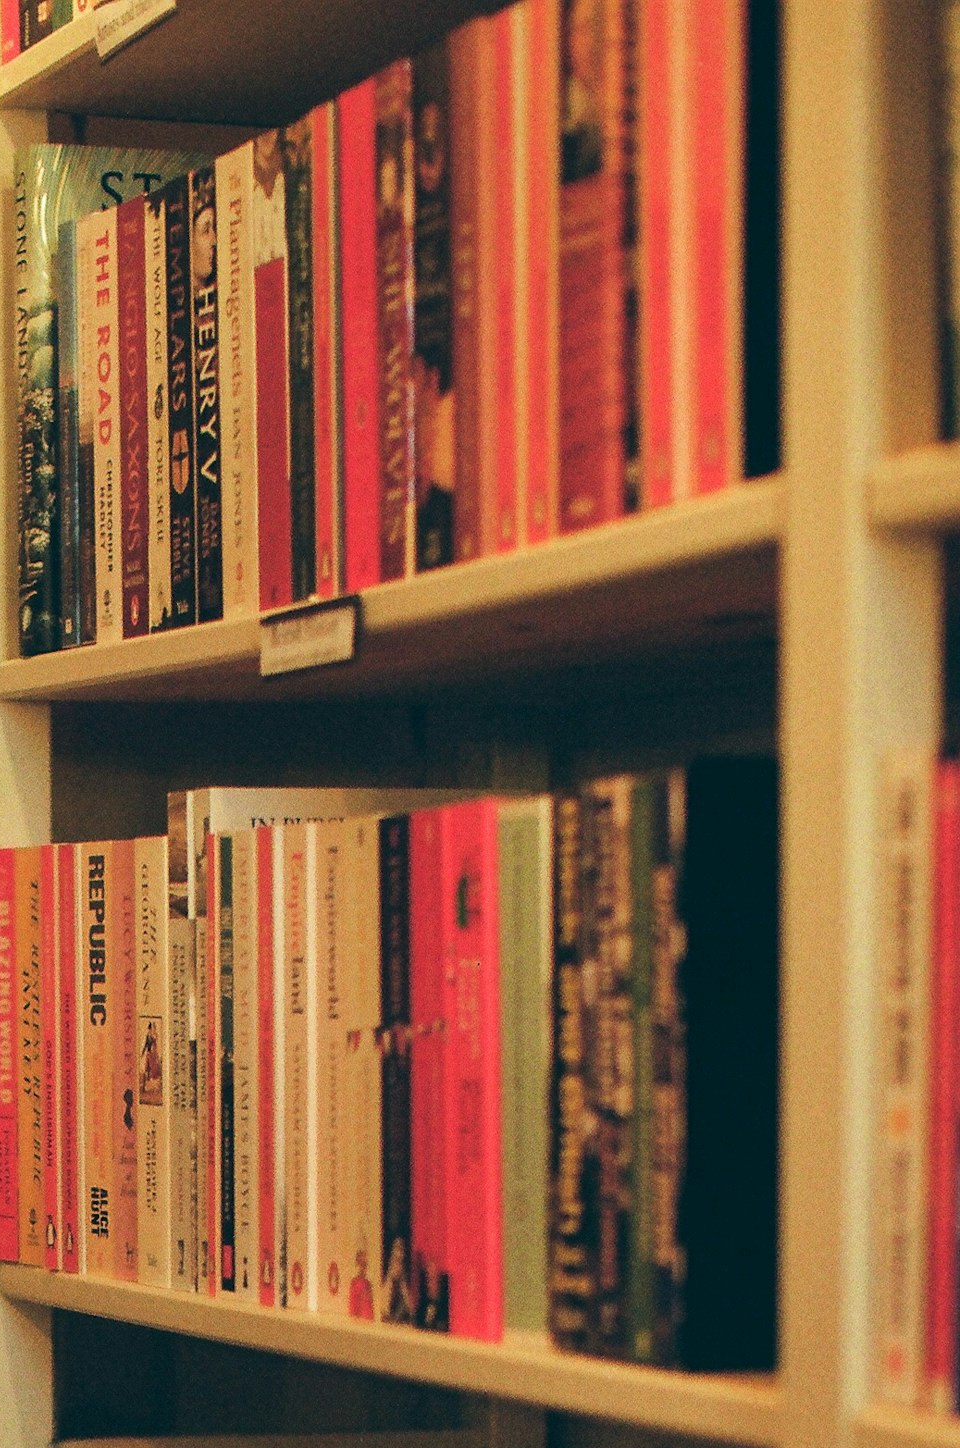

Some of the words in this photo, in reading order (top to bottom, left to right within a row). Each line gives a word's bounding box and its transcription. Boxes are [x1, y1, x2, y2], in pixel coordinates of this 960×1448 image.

[95, 231, 111, 310] THE
[153, 274, 162, 324] WOLF
[167, 201, 188, 411] TEMPLARS
[225, 200, 244, 397] Plantagenets
[97, 327, 111, 445] ROAD
[154, 334, 163, 363] AGE
[197, 286, 216, 439] HENRY
[199, 452, 217, 484] V
[88, 854, 107, 1026] REPUBLIC
[0, 1020, 12, 1105] WORLD
[44, 1082, 53, 1167] ENGLISHMAN
[90, 1186, 100, 1237] HUNT
[99, 1186, 109, 1240] ALICE
